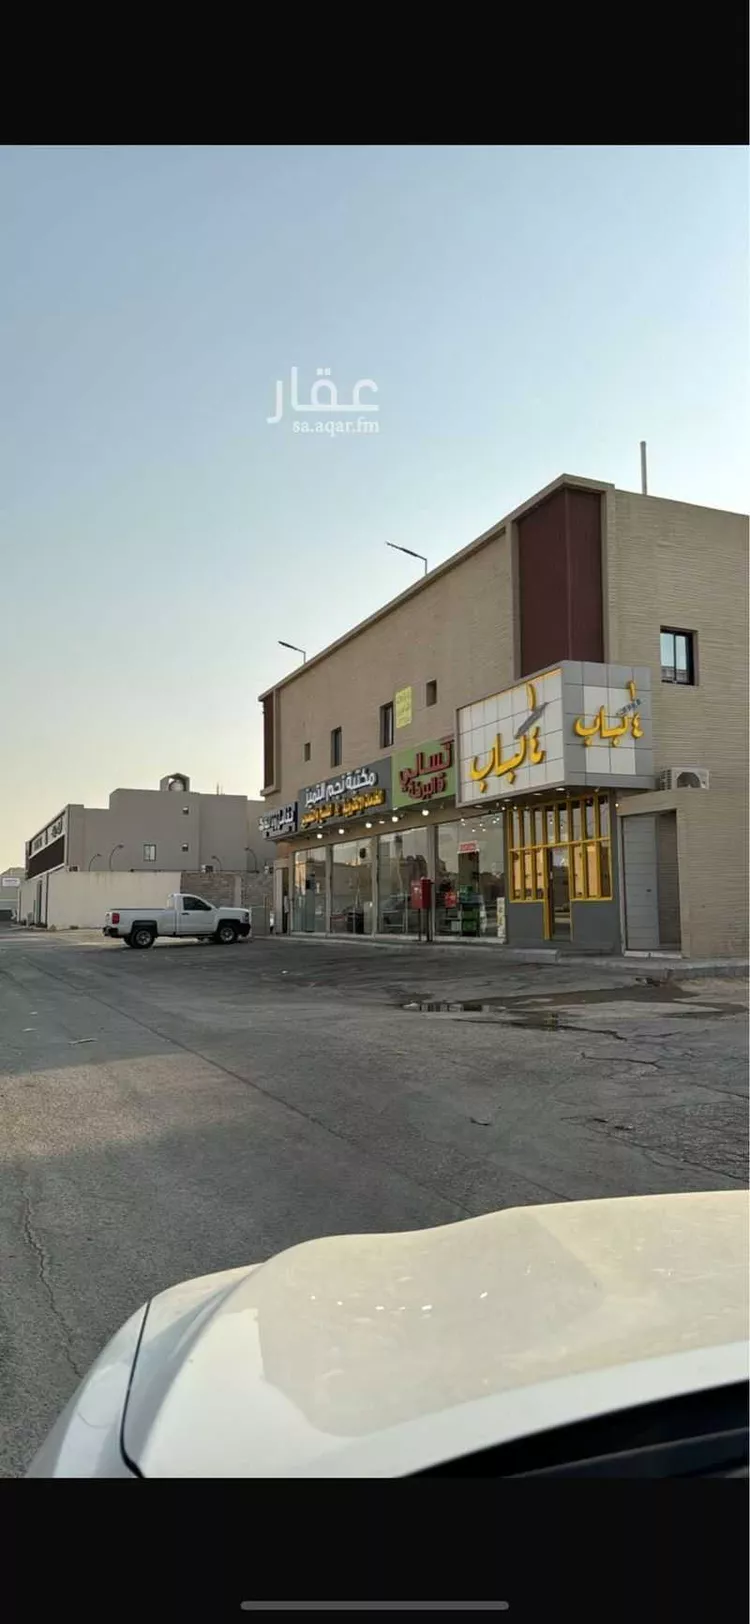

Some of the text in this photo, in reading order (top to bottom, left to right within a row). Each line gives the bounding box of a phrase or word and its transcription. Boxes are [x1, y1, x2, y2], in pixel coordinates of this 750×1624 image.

[305, 767, 377, 808] مكتبة نجم التميز
